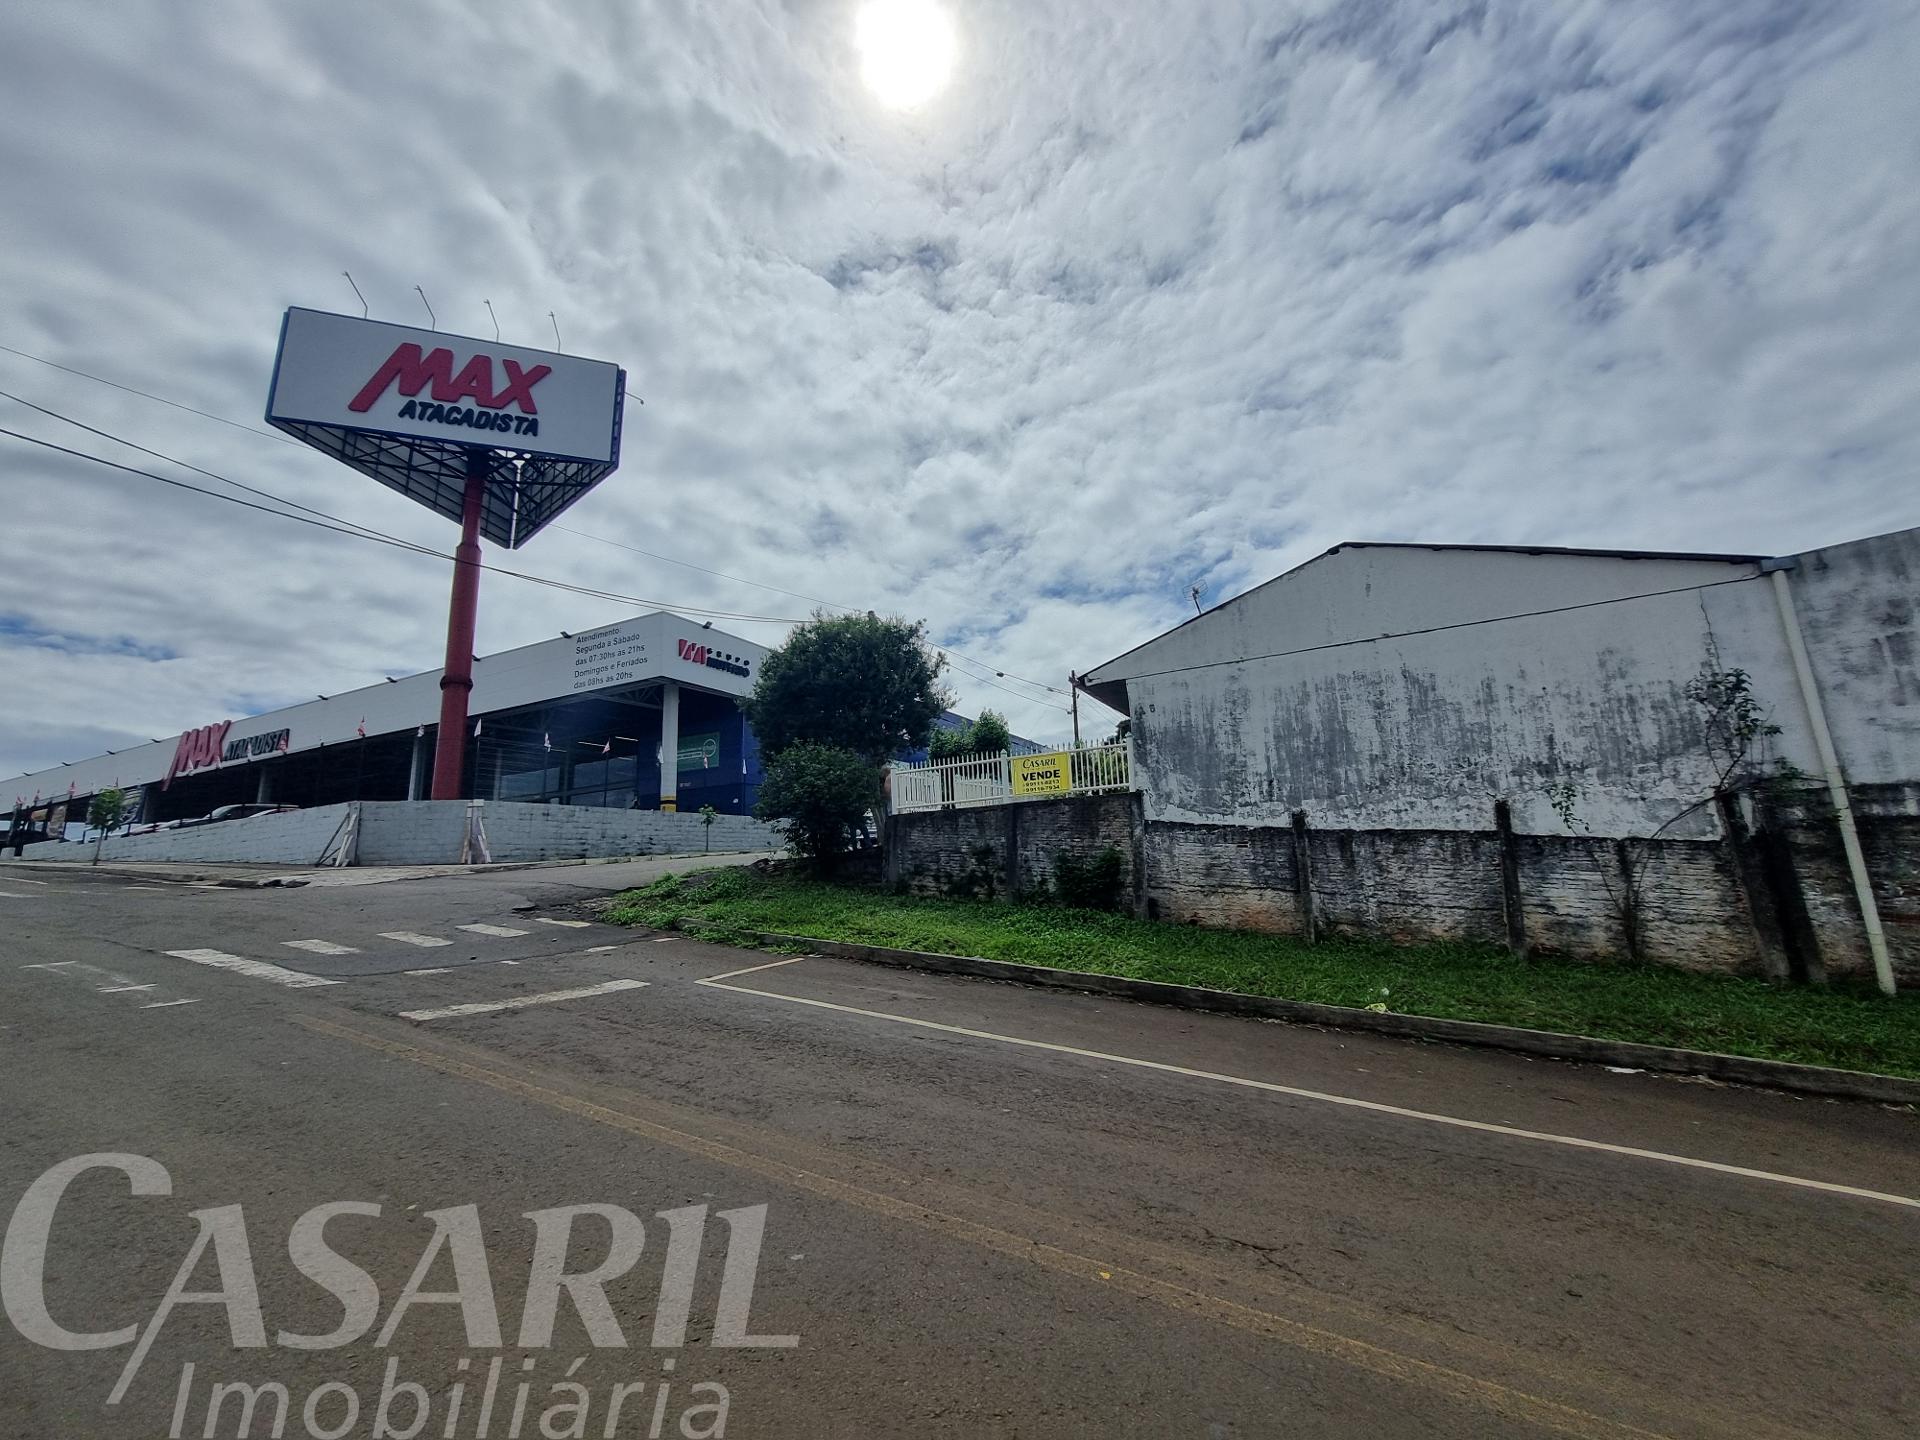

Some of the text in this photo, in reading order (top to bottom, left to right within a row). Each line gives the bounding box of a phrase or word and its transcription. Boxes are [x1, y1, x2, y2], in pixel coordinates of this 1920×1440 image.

[348, 342, 552, 414] MAX
[398, 399, 539, 437] ATACADISTA
[576, 642, 605, 654] Segunda
[627, 645, 645, 654] 21hs
[574, 665, 609, 679] Domingos
[616, 656, 648, 669] Feriados
[573, 681, 586, 689] das
[615, 672, 633, 681] 20hs
[162, 719, 232, 792] MAX
[1022, 758, 1057, 769] CASARIL
[1021, 769, 1061, 782] VENDE
